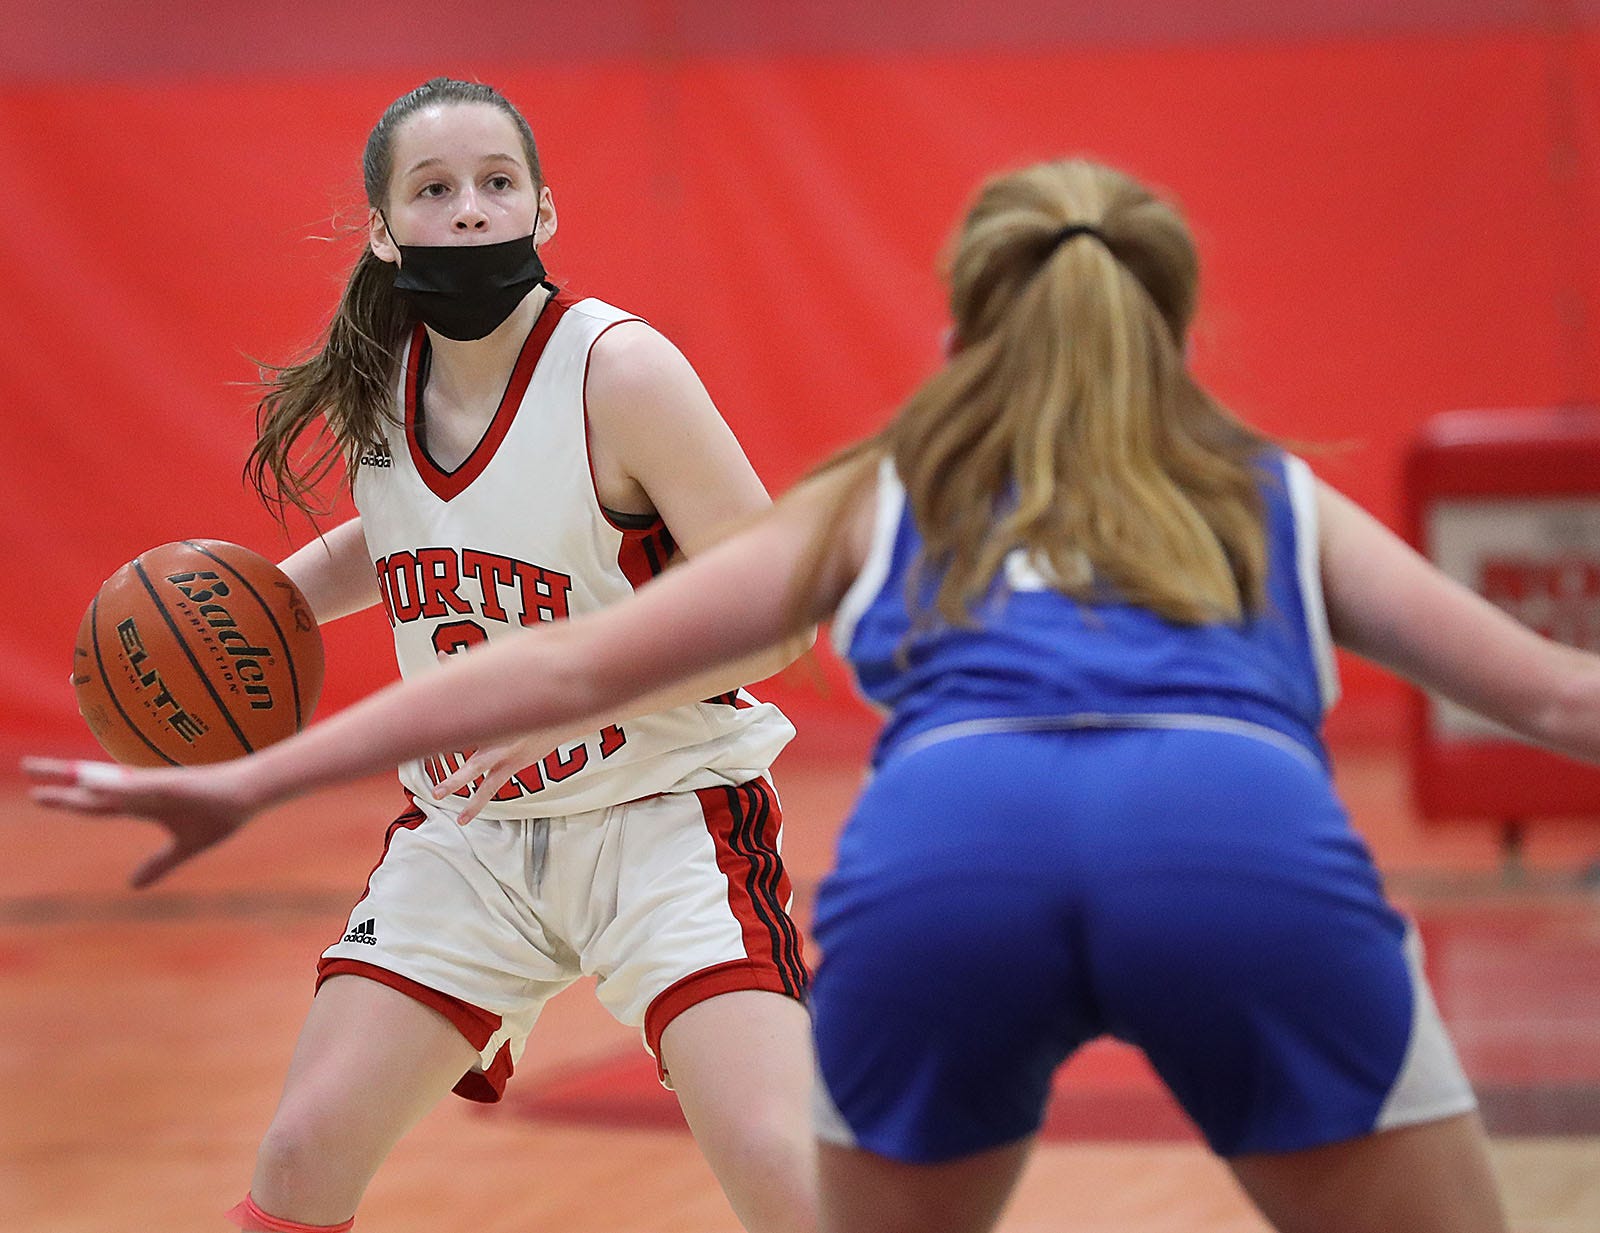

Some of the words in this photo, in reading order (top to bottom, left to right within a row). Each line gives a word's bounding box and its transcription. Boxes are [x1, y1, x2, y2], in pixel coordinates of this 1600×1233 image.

[116, 616, 204, 744] ELITE
[166, 571, 273, 711] Baden
[177, 602, 238, 693] PERFECTION
[343, 931, 377, 946] adidas
